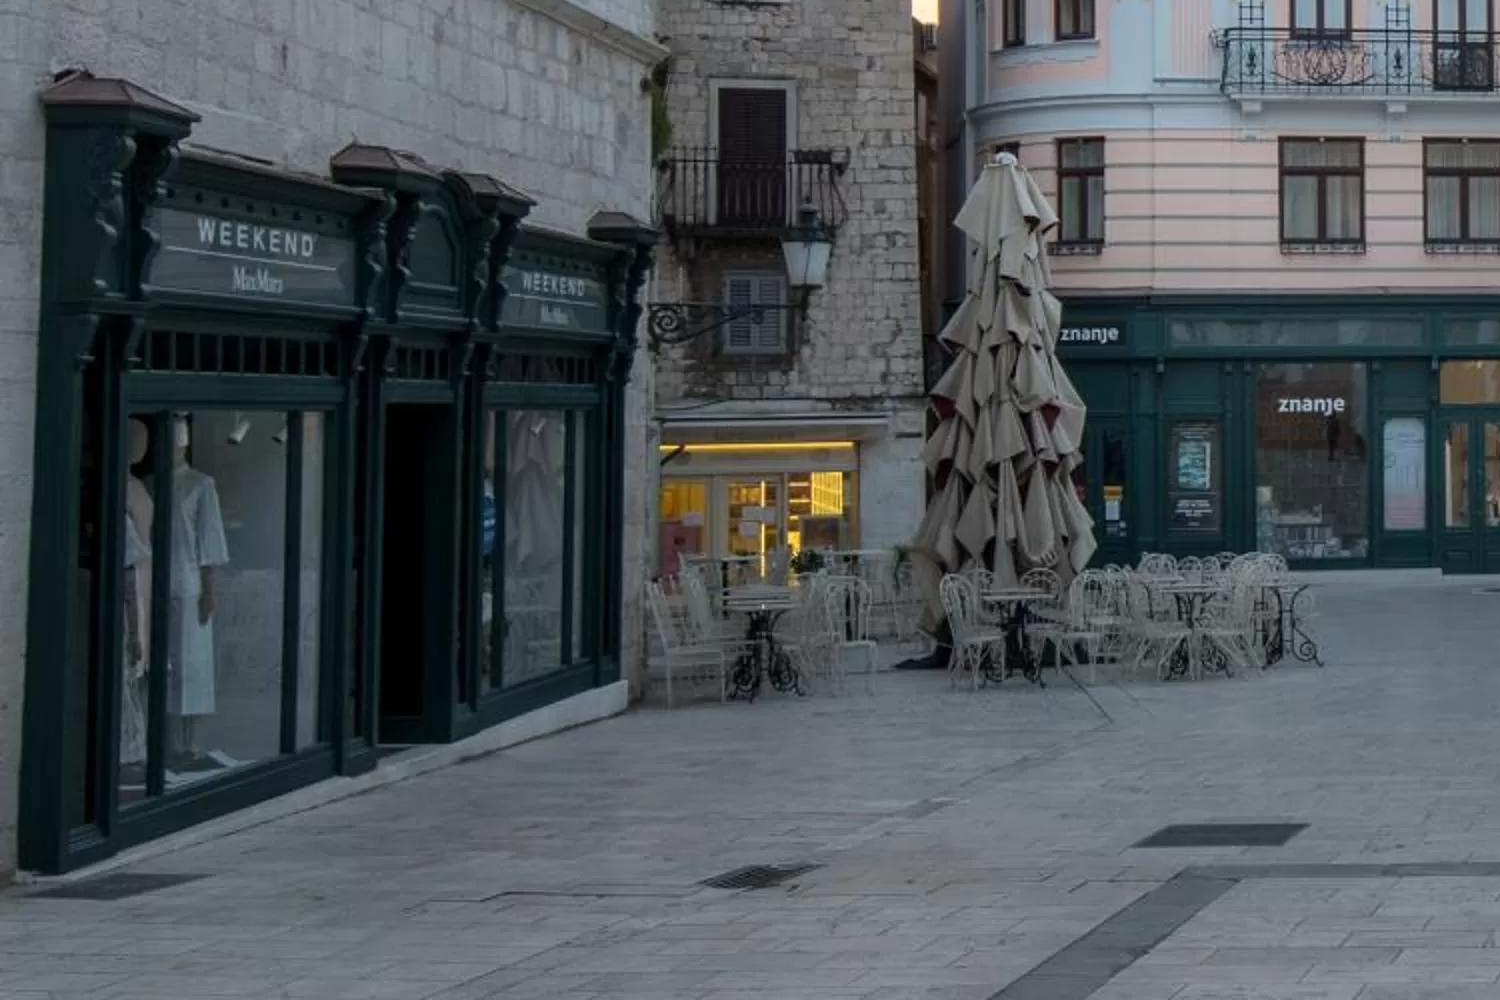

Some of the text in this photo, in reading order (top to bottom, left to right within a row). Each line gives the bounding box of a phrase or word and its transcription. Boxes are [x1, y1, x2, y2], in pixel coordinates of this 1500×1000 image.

[197, 217, 315, 257] WEEKEND
[521, 271, 584, 297] WEEKEND
[1060, 327, 1119, 344] znanje
[1278, 397, 1345, 416] znanje
